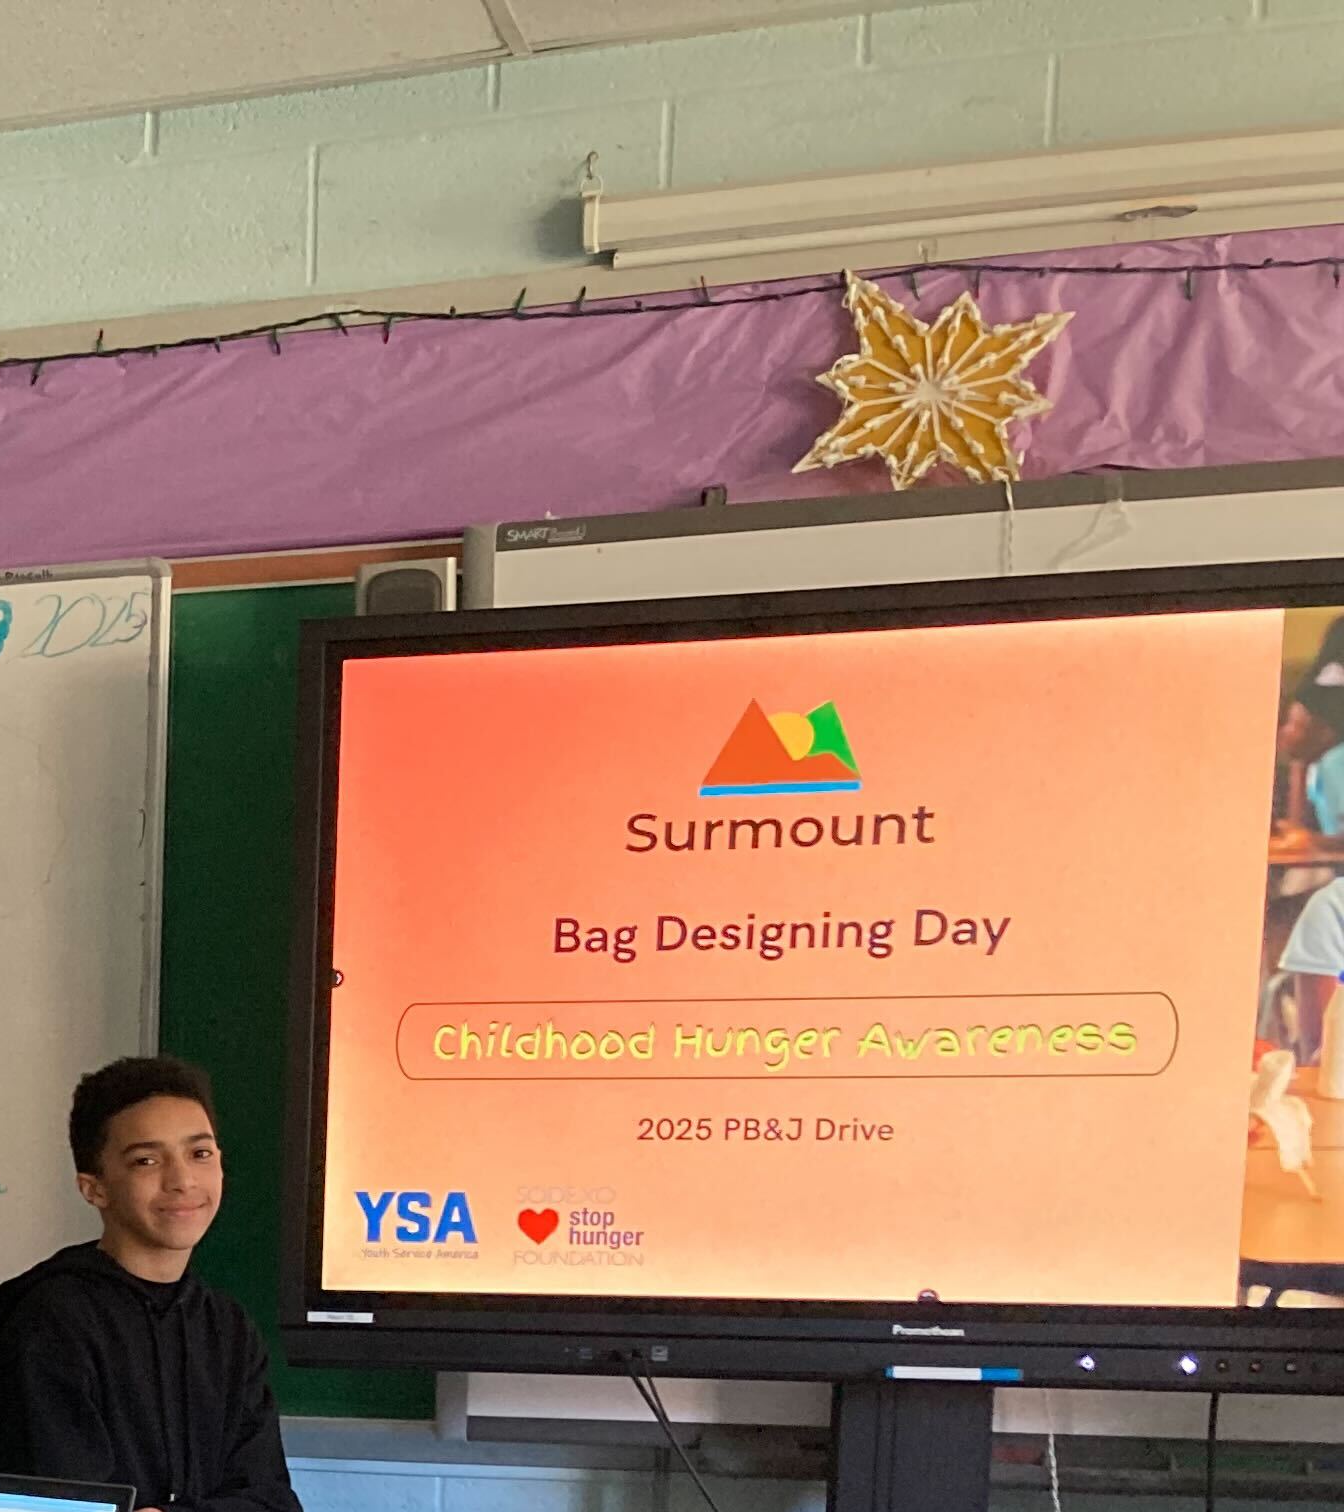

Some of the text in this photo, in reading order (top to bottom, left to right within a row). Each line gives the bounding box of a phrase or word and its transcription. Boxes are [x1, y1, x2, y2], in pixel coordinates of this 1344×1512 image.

[504, 526, 549, 542] SMART
[12, 591, 150, 659] 2025
[624, 804, 937, 855] Surmount
[553, 908, 1012, 963] Bag Designing Day
[432, 1018, 1140, 1072] Childhood Hunger Awareness
[636, 1116, 895, 1142] 2025 PB&J Drive
[354, 1190, 479, 1244] YSA
[569, 1208, 615, 1230] stop
[569, 1227, 645, 1250] hunger
[361, 1248, 390, 1260] Youth
[512, 1251, 645, 1267] FOUNDATION
